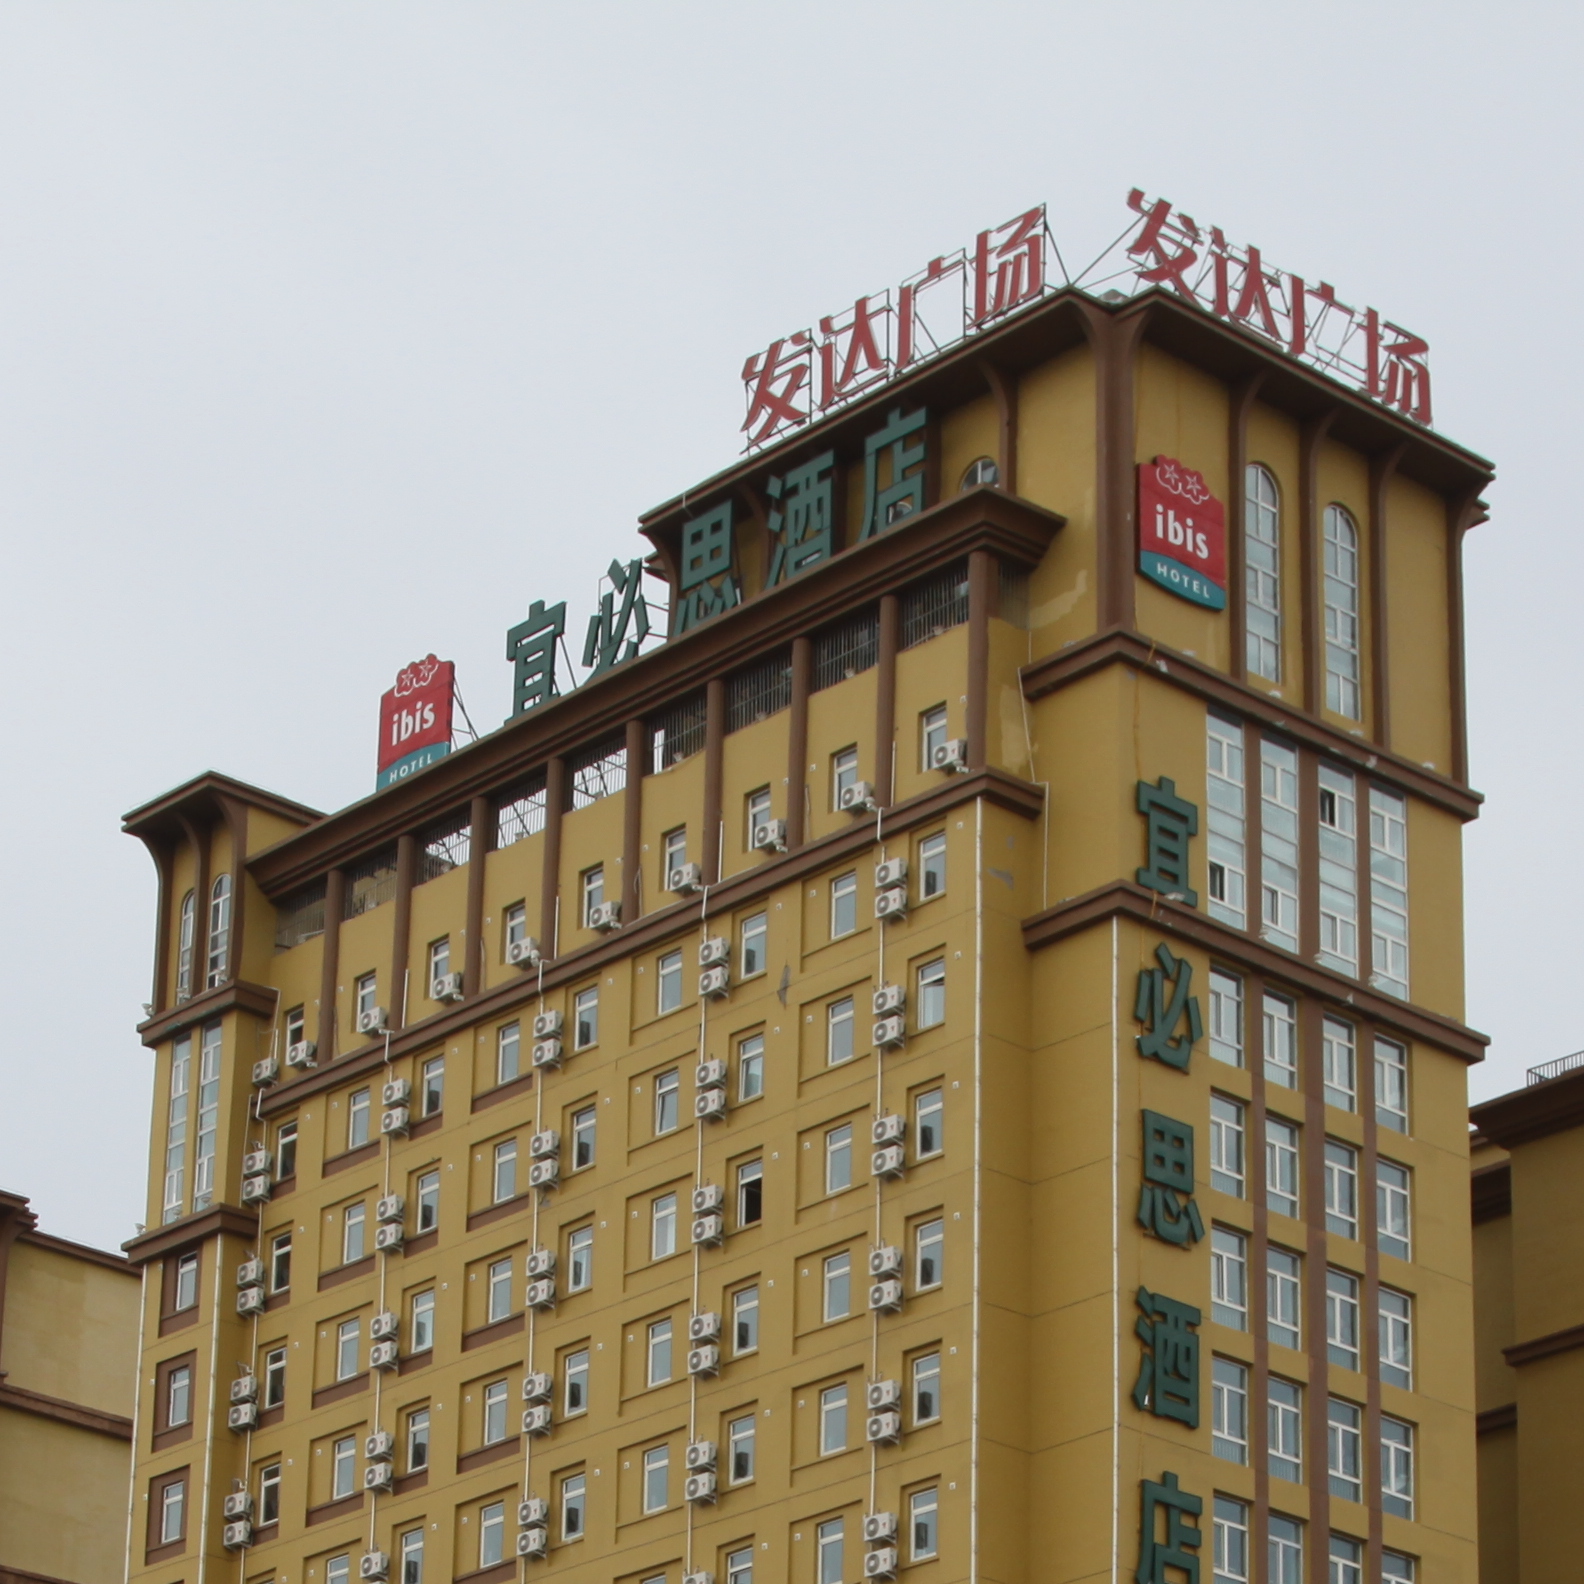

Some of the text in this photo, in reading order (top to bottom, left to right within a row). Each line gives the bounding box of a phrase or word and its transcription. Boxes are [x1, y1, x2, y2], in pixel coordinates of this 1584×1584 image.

[741, 204, 1047, 447] 发达广场
[1126, 187, 1433, 424] 发达广场
[1155, 503, 1210, 560] ibis
[505, 406, 930, 726] 宜必思酒店
[1156, 562, 1211, 599] HOTEL
[390, 700, 436, 747] ibis
[389, 754, 434, 784] HOTEL
